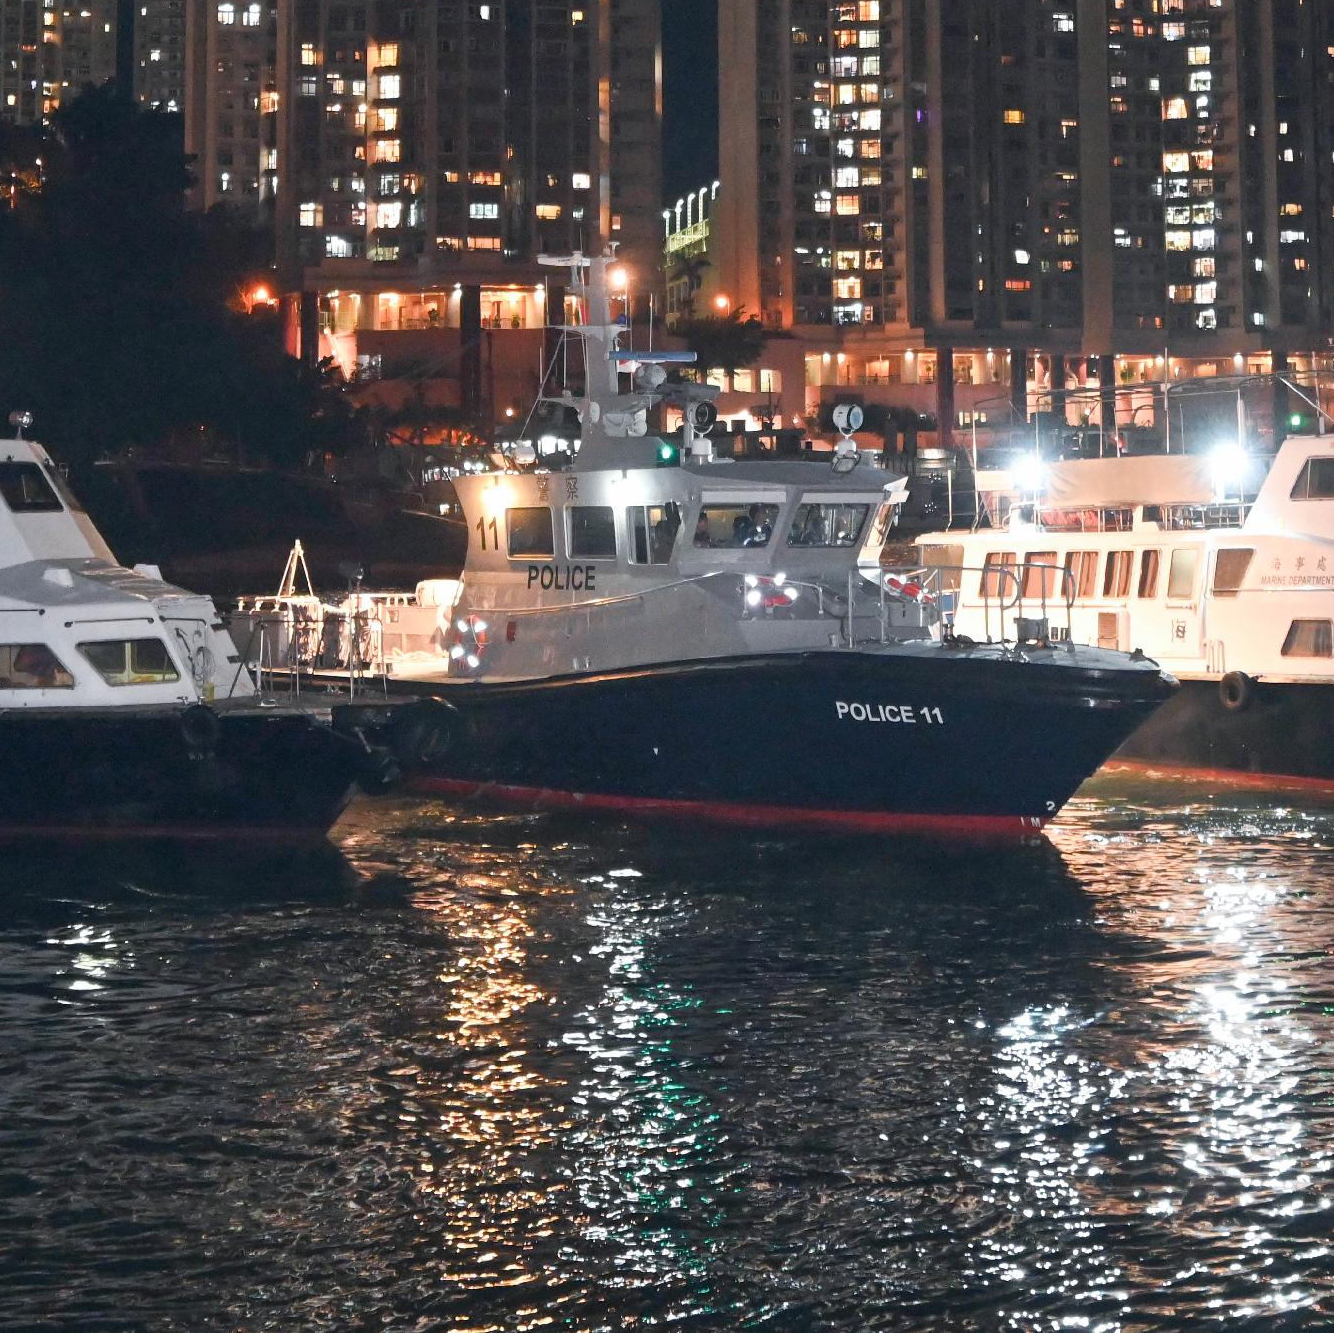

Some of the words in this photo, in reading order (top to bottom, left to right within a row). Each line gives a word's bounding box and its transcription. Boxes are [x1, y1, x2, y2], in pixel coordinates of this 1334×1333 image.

[536, 475, 579, 501] 警察
[476, 516, 499, 551] 11
[527, 564, 596, 591] POLICE
[1260, 575, 1287, 586] MARINE
[835, 701, 917, 723] POLICE
[919, 706, 944, 724] 11
